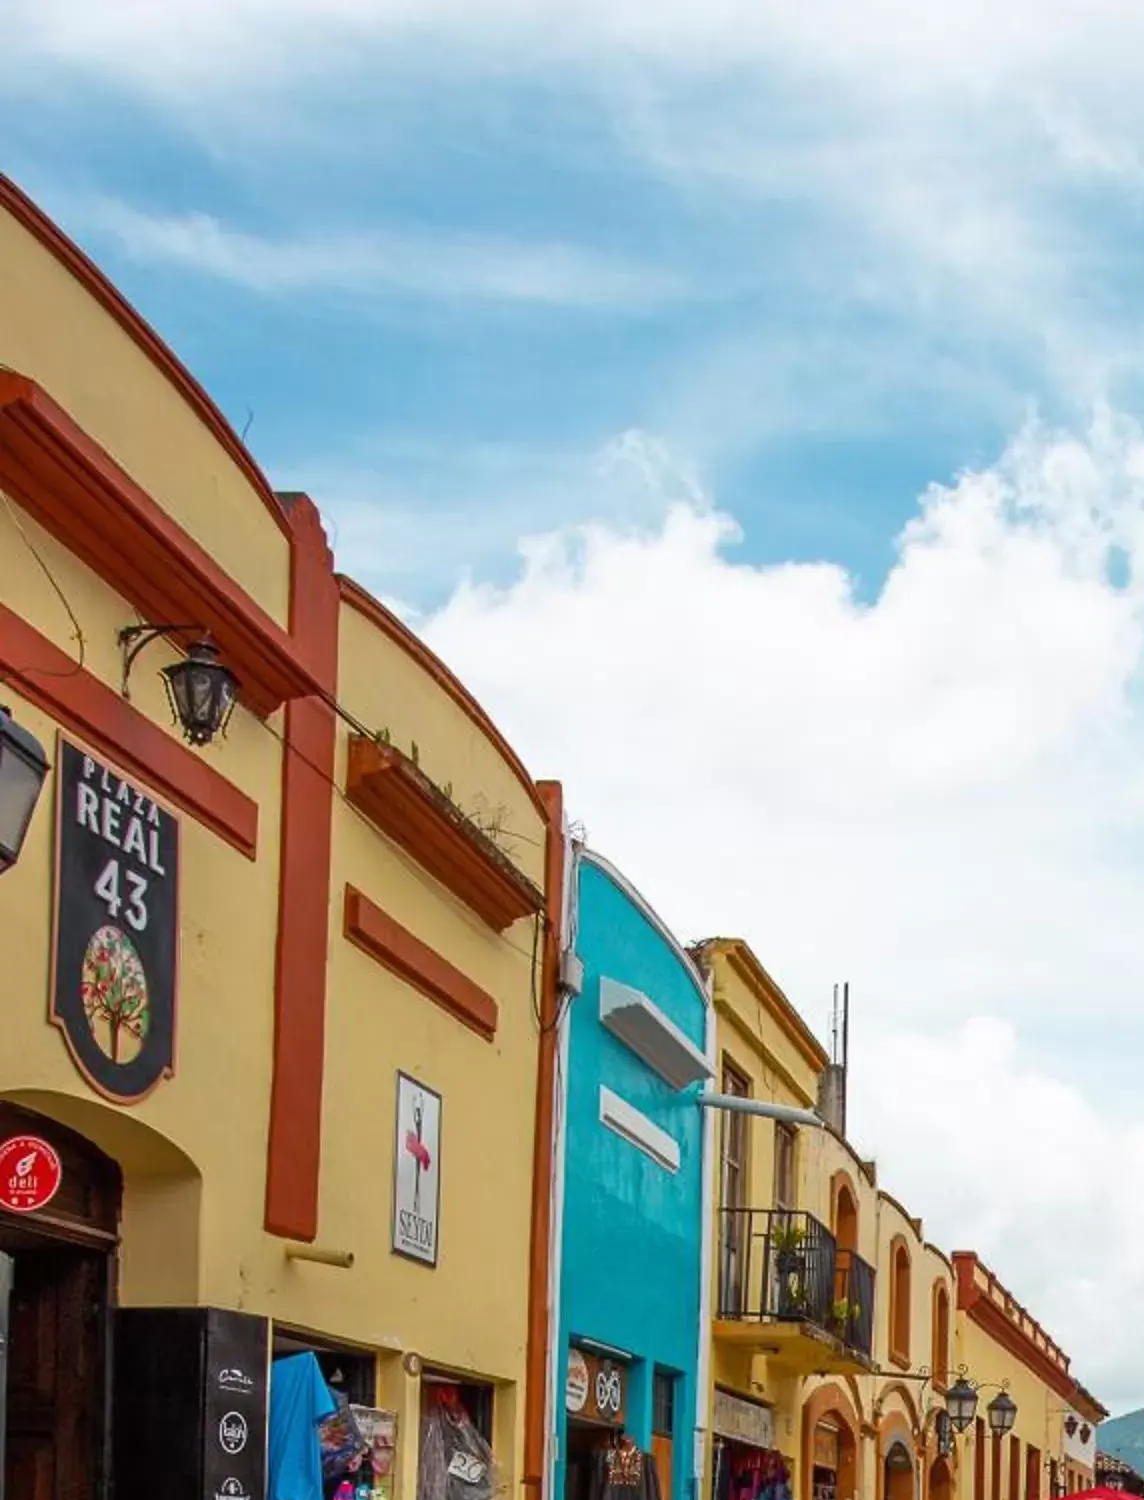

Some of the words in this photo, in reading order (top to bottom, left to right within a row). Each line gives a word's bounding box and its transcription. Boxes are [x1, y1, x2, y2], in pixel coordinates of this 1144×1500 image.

[82, 755, 160, 828] PLAZA
[76, 781, 166, 876] REAL
[94, 859, 149, 931] 43
